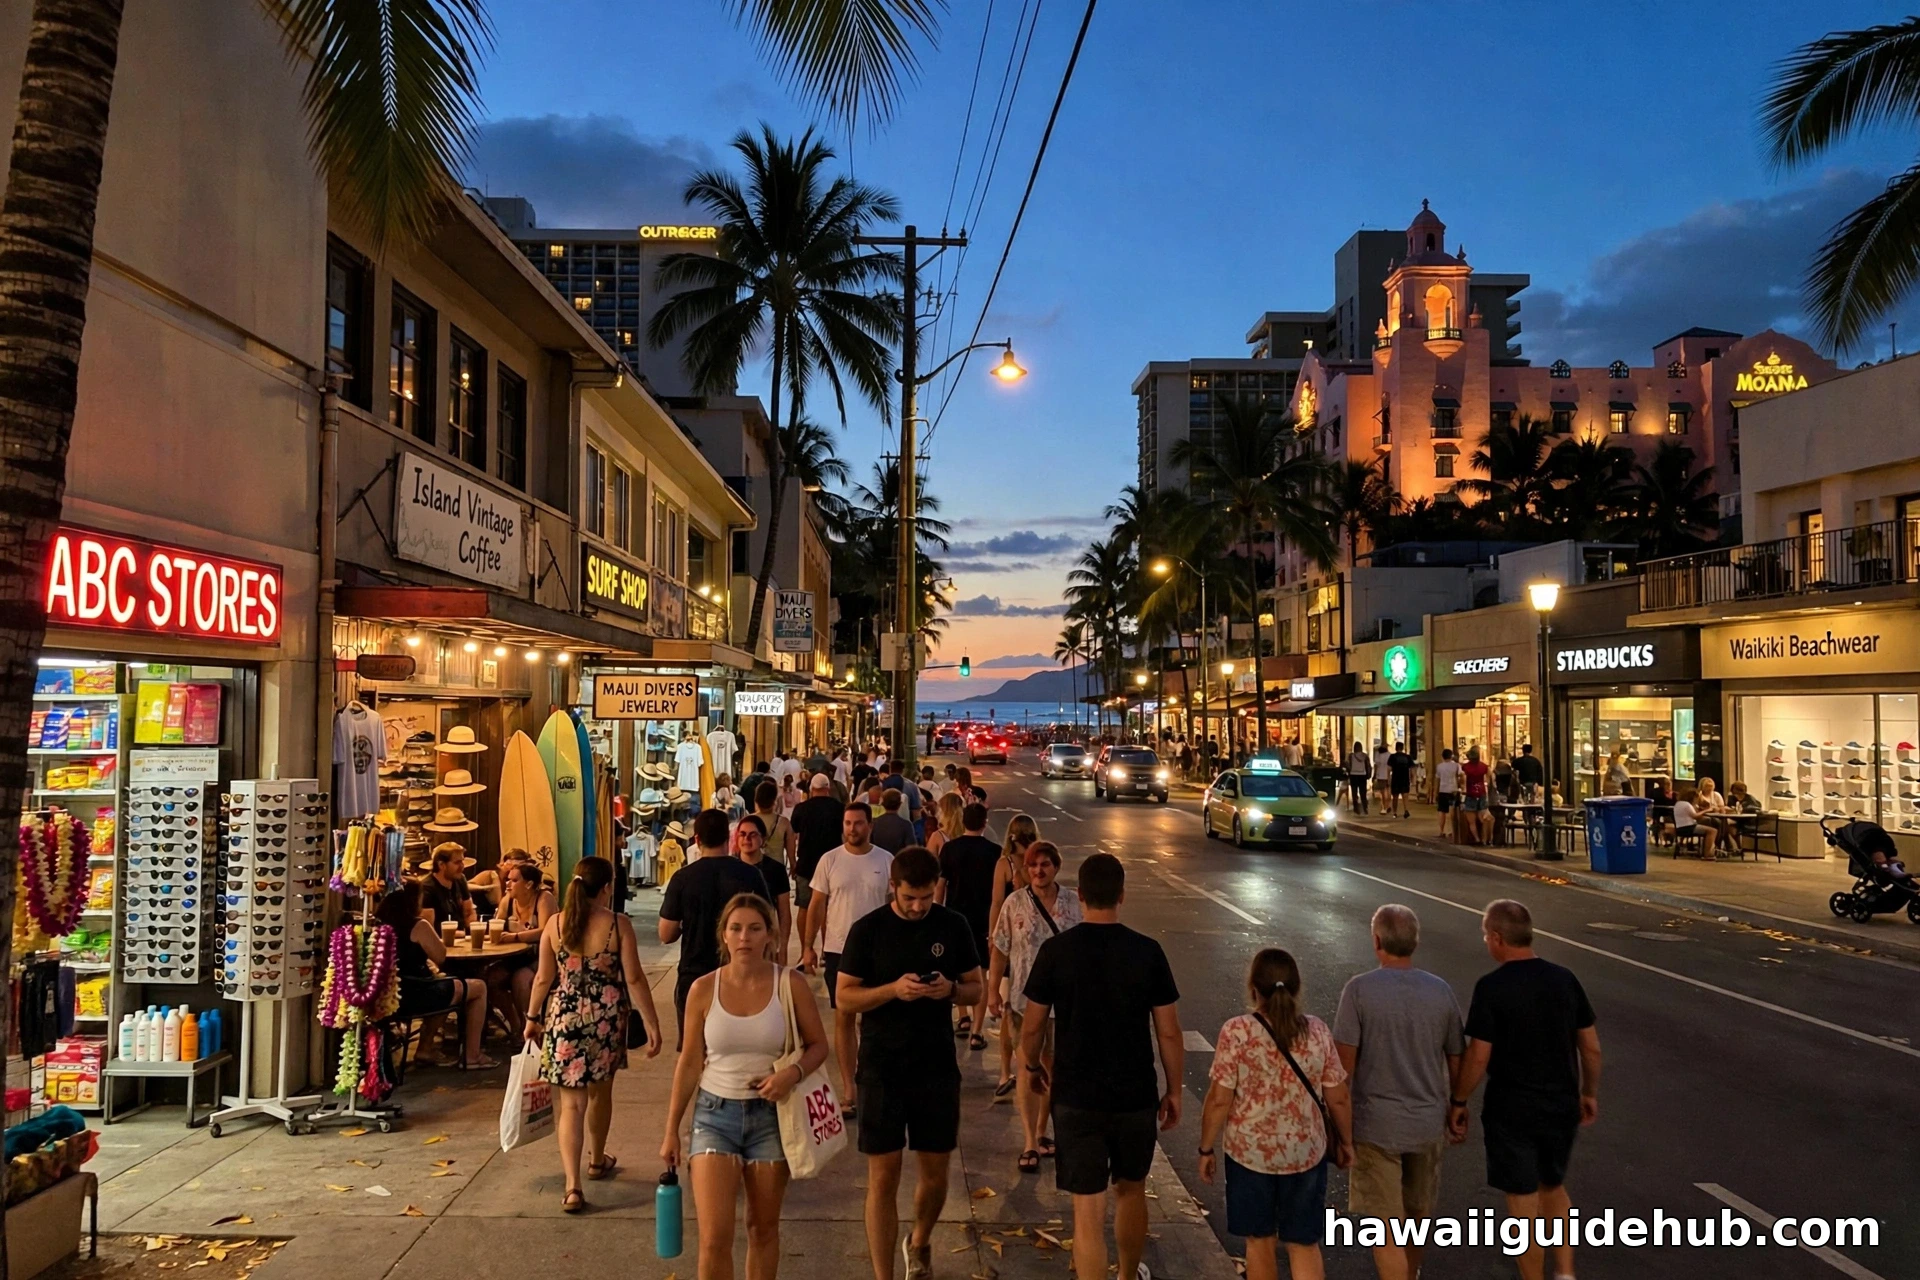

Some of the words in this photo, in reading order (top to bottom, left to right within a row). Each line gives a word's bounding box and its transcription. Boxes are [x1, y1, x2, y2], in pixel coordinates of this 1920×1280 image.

[1736, 373, 1808, 392] MOANA
[412, 467, 461, 518] Island
[467, 490, 514, 545] Vintage
[458, 531, 501, 573] Coffee
[47, 536, 136, 623] ABC
[148, 554, 277, 637] STORES
[587, 554, 618, 601] SURF
[620, 569, 647, 611] SHOP
[1556, 643, 1654, 672] STARBUCKS
[1730, 636, 1784, 660] Waikiki
[1789, 631, 1880, 657] Beachwear
[1452, 656, 1509, 675] SKECHERS
[603, 682, 638, 696] MAUI
[645, 682, 694, 697] DIVERS
[618, 699, 678, 714] JEWELRY
[806, 1083, 835, 1127] ABC
